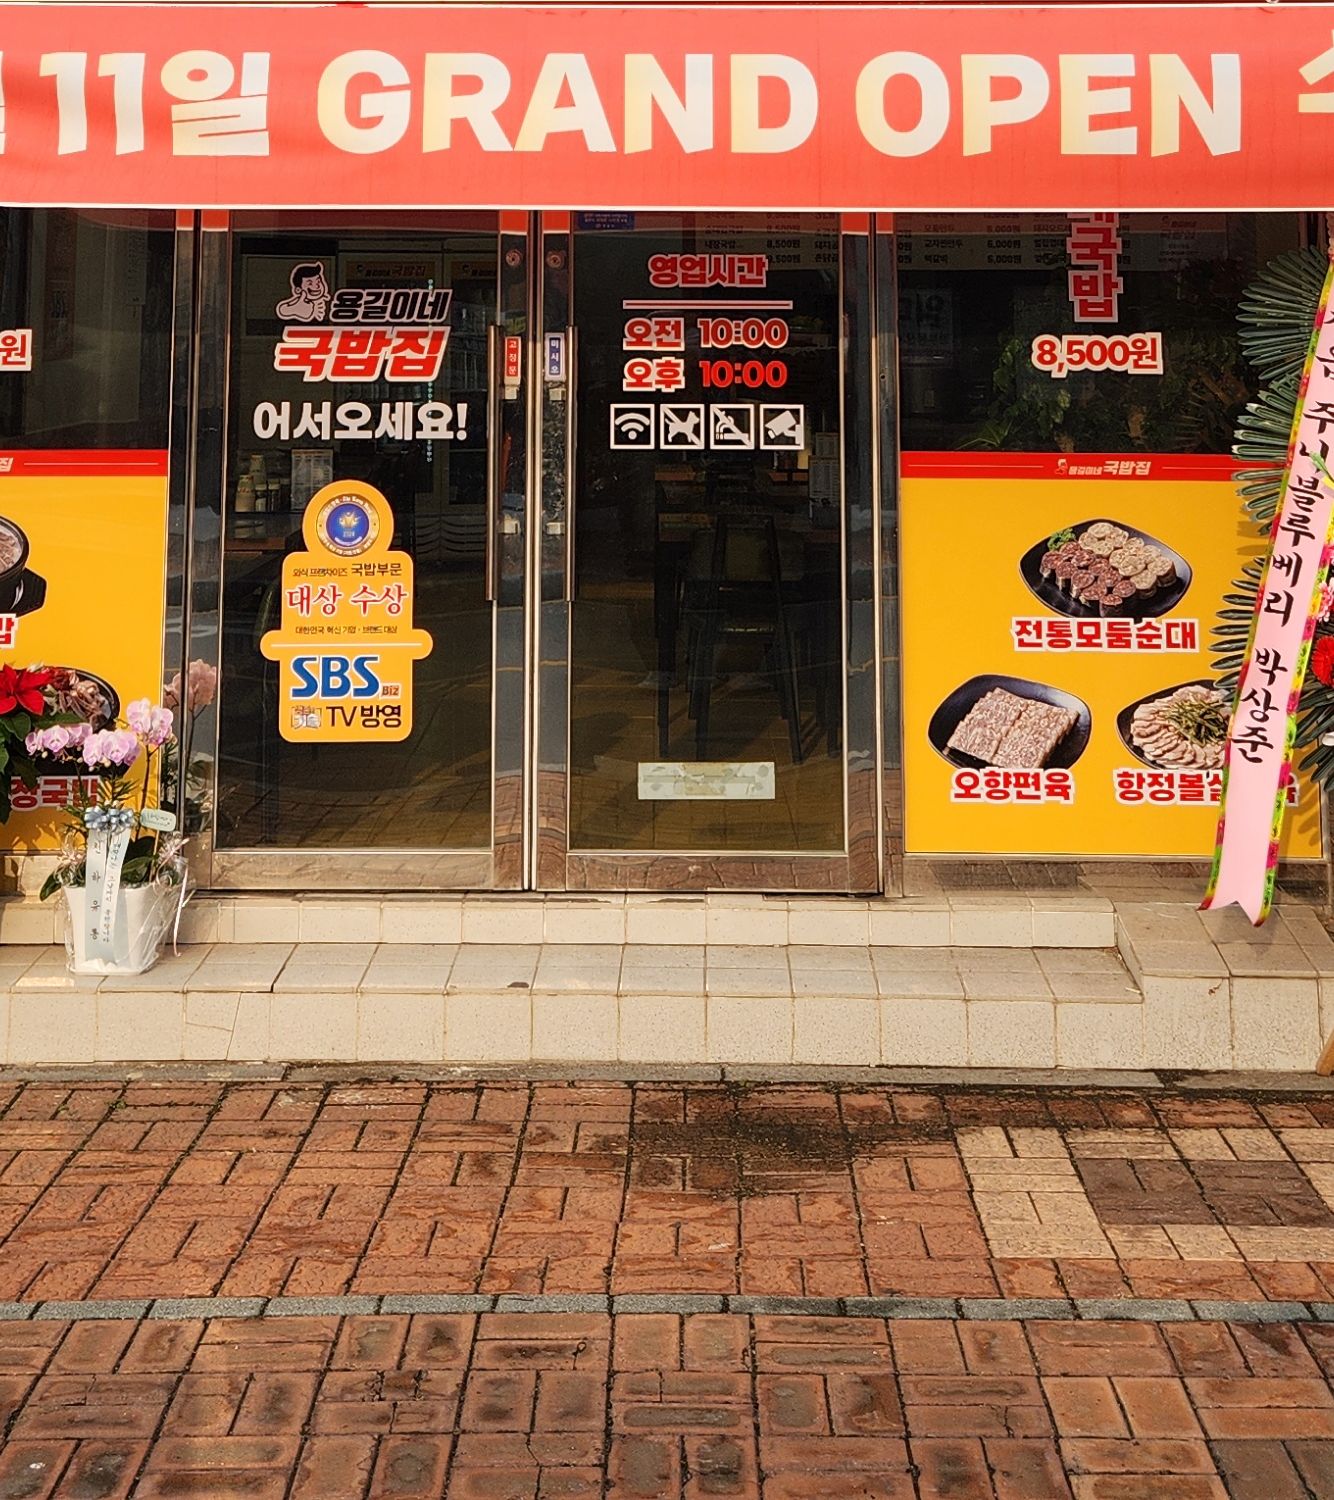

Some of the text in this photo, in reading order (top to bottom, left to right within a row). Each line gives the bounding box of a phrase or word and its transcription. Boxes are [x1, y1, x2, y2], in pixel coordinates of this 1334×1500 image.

[39, 50, 270, 157] 11일
[316, 48, 819, 155] GRAND
[854, 49, 1242, 157] OPEN
[648, 253, 767, 288] 영업시간
[1068, 213, 1123, 322] 국밥
[331, 289, 453, 323] 용길이네
[623, 317, 789, 351] 오전 10:00
[275, 327, 450, 382] 국밥집
[507, 337, 518, 376] 고정문
[550, 336, 561, 377] 미시오
[1033, 334, 1162, 376] 8,500원
[623, 357, 788, 393] 오후 10:00
[252, 401, 468, 441] 어서오세요!
[1102, 460, 1152, 476] 국밥집
[351, 562, 403, 577] 국밥부문
[286, 583, 408, 616] 대상 수상
[1013, 618, 1197, 651] 전통모둠순대
[291, 655, 400, 698] SBS Biz
[325, 705, 358, 727] TV
[360, 704, 402, 728] 방영
[952, 770, 1073, 802] 오향편육
